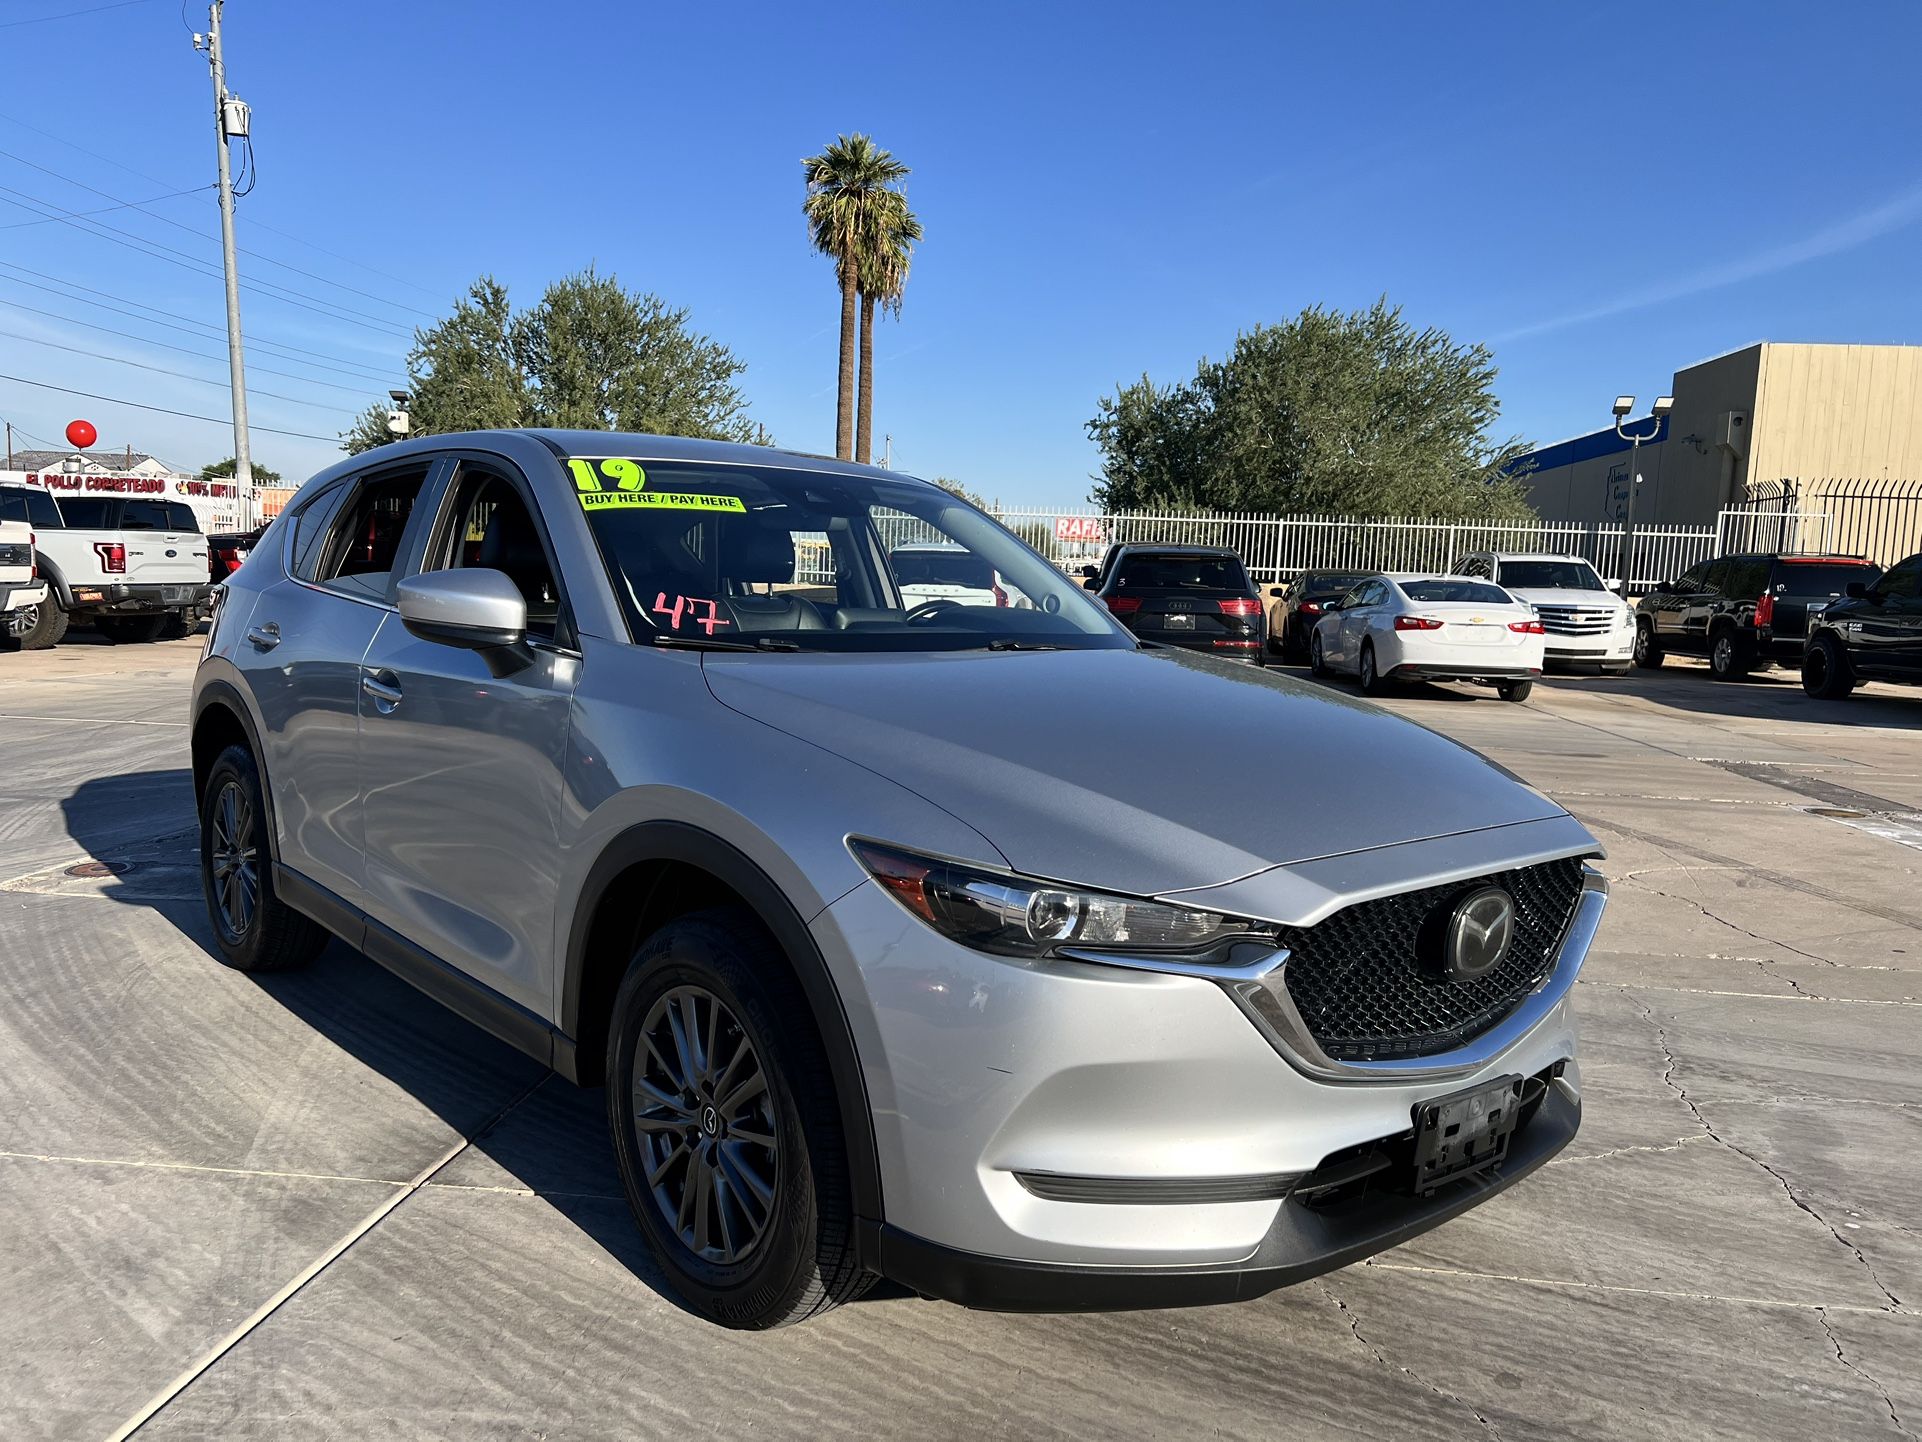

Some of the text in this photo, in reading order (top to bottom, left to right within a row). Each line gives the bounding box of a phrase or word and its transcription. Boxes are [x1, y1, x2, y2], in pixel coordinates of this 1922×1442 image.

[44, 474, 83, 491] POLLO
[567, 459, 646, 492] 19
[585, 493, 613, 505] BUY
[618, 493, 656, 504] HERE
[670, 495, 695, 505] PAY
[700, 496, 736, 507] HERE
[1057, 518, 1097, 535] RAFI
[652, 592, 730, 635] 47
